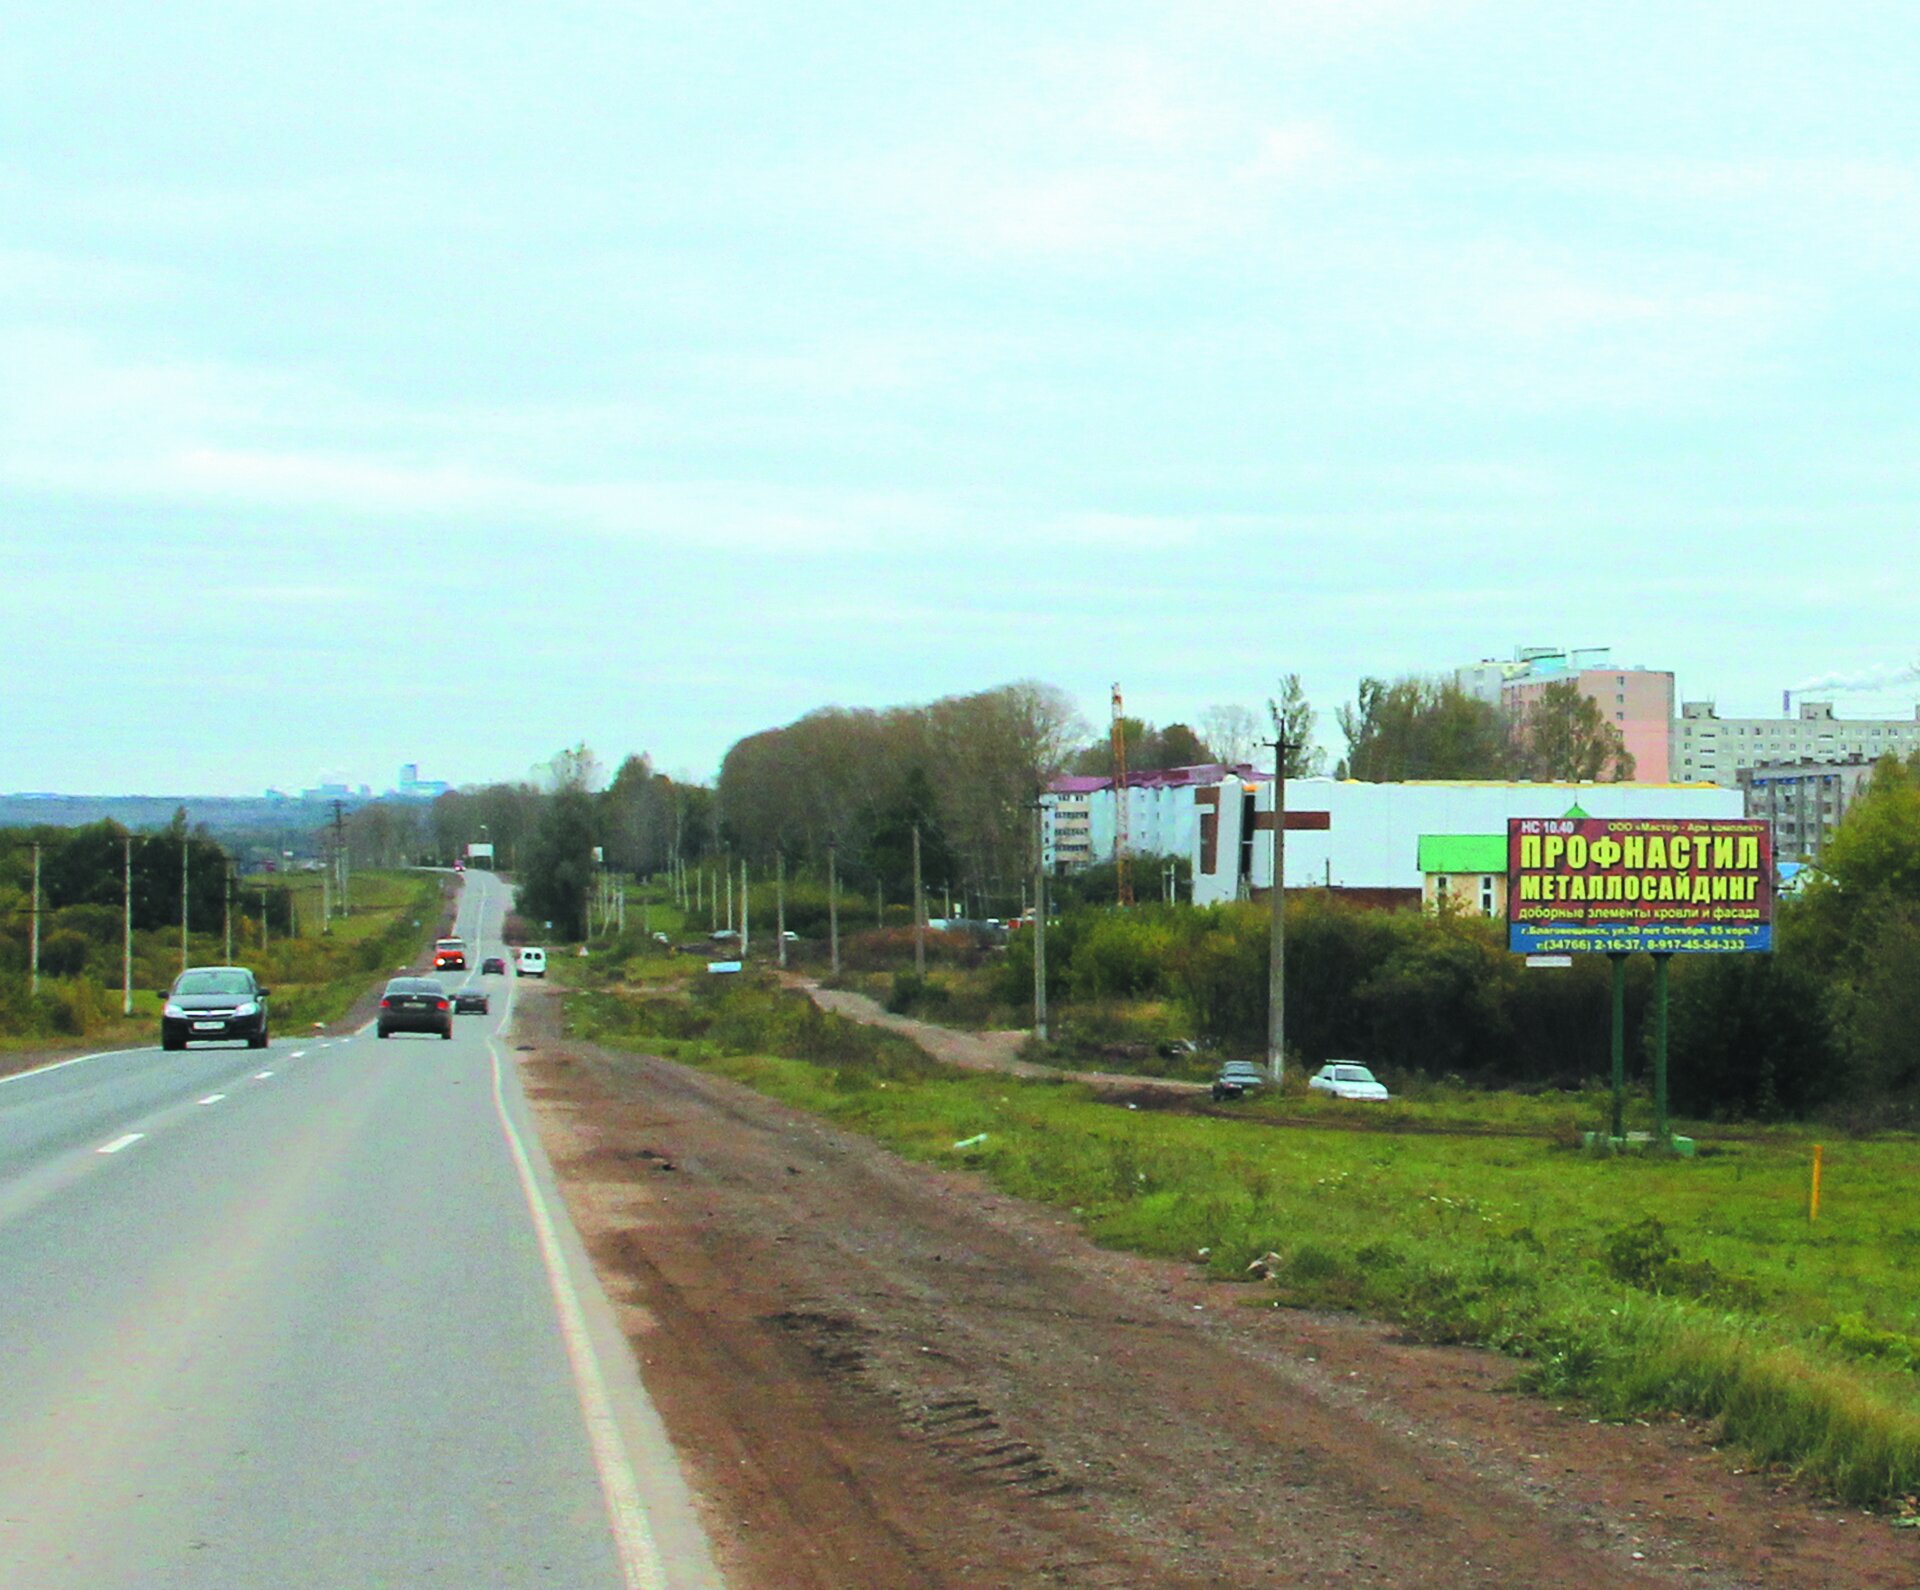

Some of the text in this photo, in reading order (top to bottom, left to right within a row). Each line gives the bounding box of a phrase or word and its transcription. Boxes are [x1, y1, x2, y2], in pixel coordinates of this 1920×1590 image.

[1521, 821, 1574, 833] НС 10.40
[1608, 822, 1632, 831] ООО
[1520, 834, 1758, 869] ПРОФНАСТИЛ
[1520, 872, 1758, 904] МЕТАЛЛОСАЙДИНГ
[1519, 905, 1760, 921] доборные элементы кровли и фасада
[1647, 939, 1745, 950] 8-917-45-54-333
